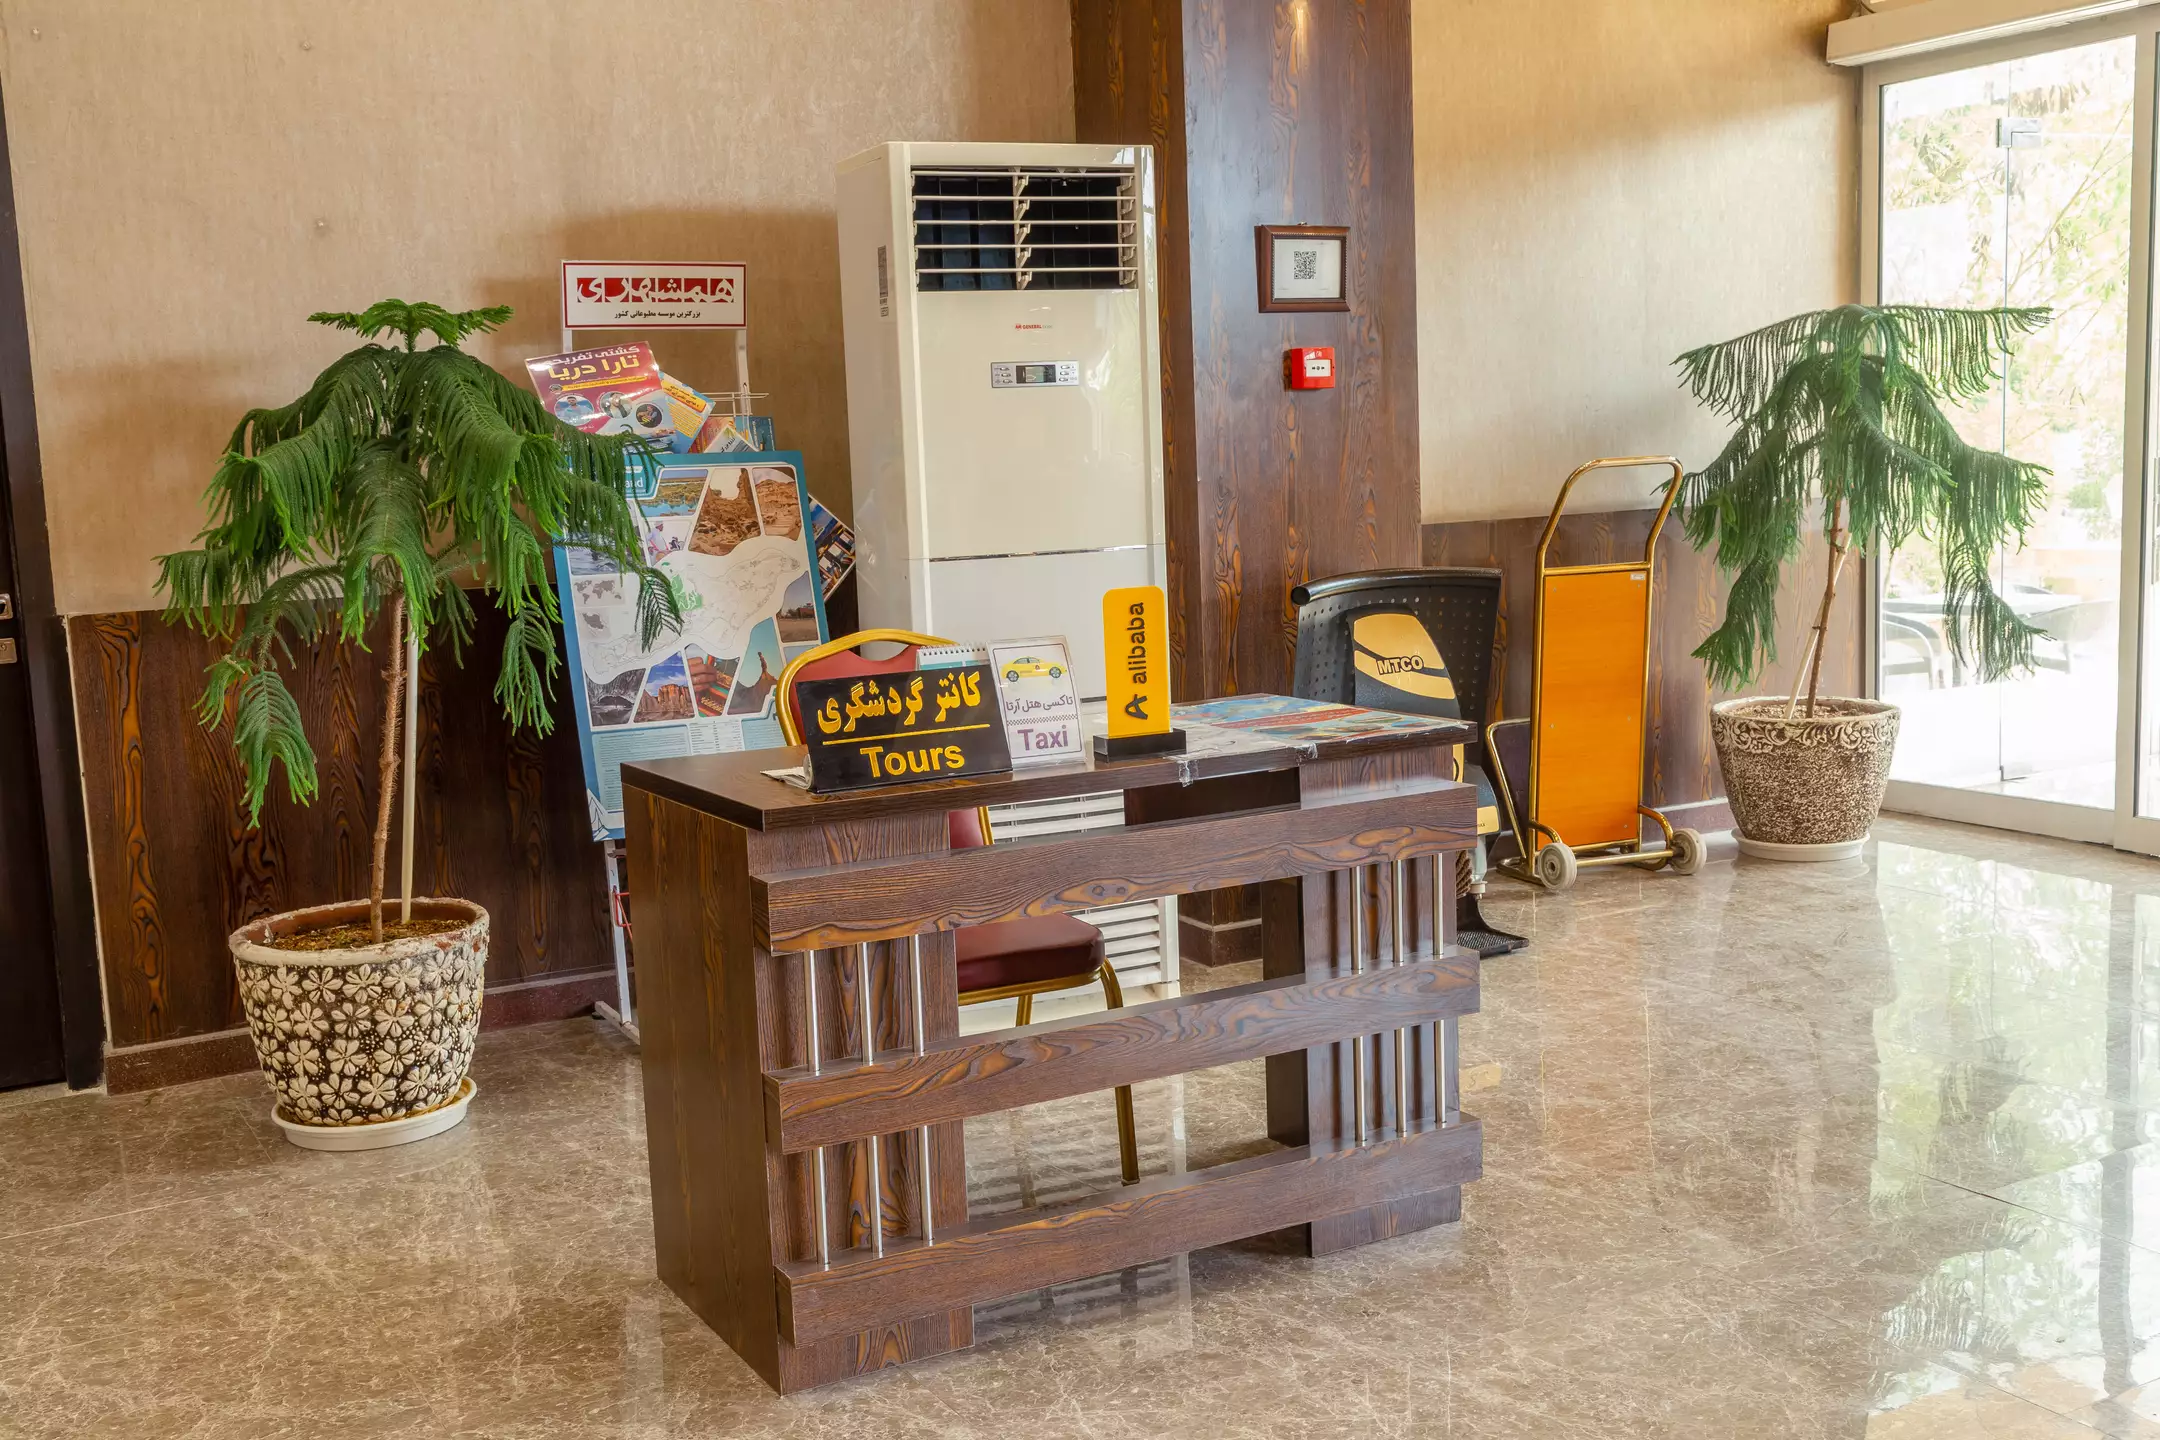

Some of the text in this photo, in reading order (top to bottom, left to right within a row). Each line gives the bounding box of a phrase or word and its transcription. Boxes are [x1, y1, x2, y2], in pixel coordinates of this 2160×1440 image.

[576, 278, 735, 303] همشهری
[614, 309, 701, 319] بزرگترین موسسه مطبوعاتی کشور
[547, 345, 640, 367] کشتی تفریح
[601, 355, 640, 375] تارا
[548, 364, 597, 381] دریا
[1127, 602, 1148, 684] alibaba
[817, 676, 924, 734] گردشگری
[934, 670, 981, 723] کانتر
[1005, 694, 1073, 714] تاکسی هتل آرتا
[1017, 724, 1069, 751] Taxi
[860, 745, 966, 778] Tours
